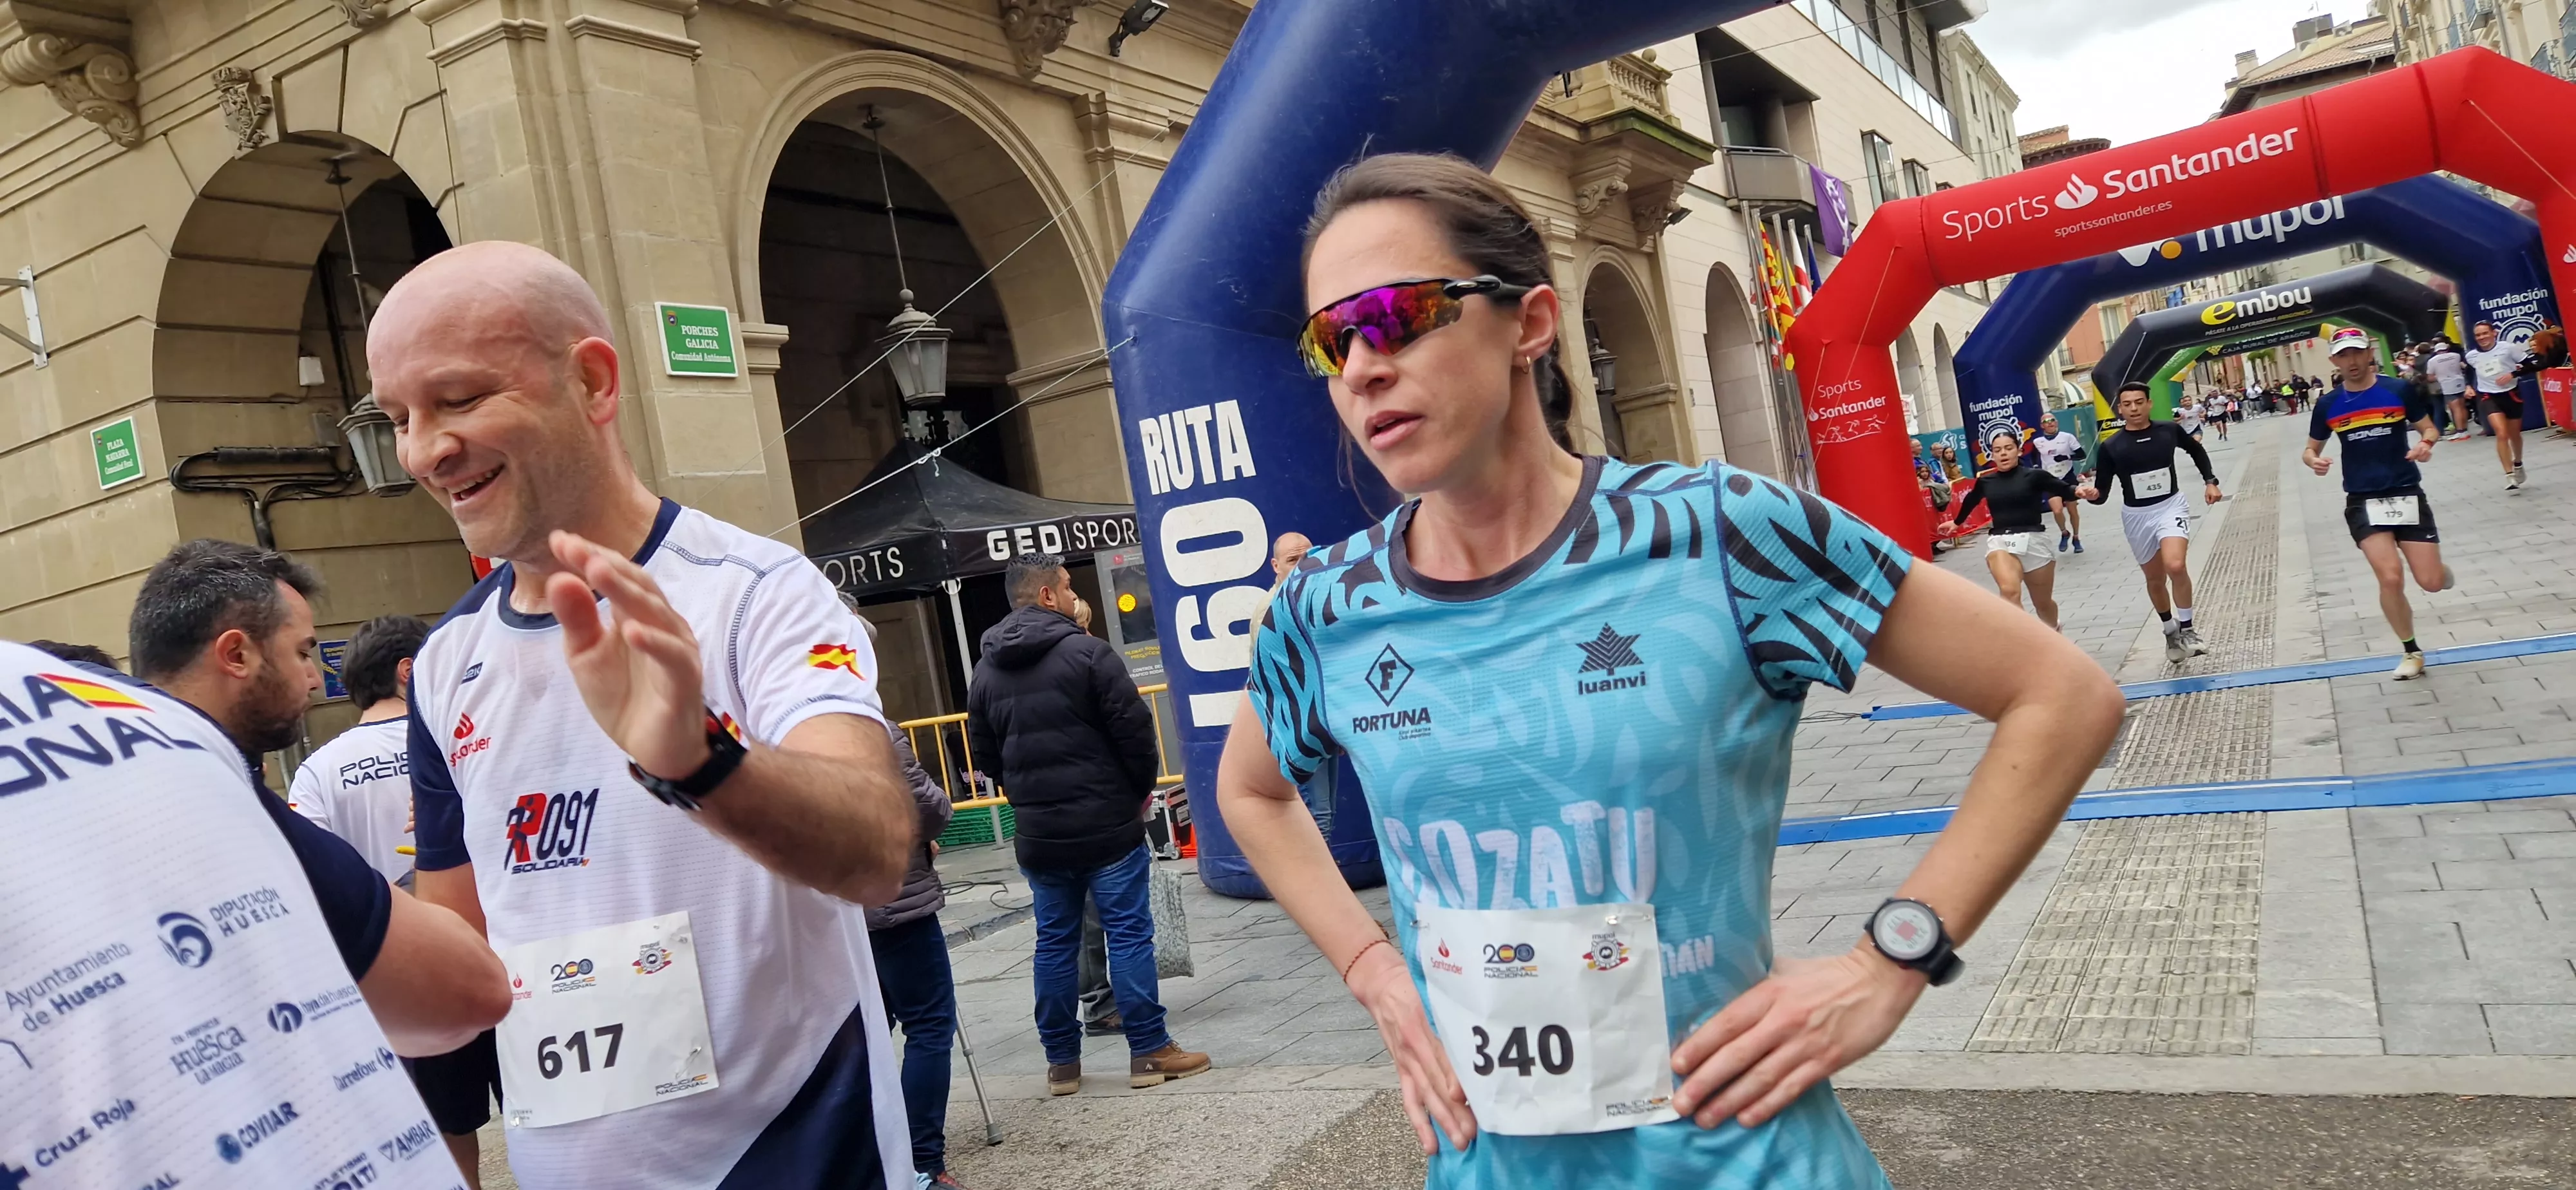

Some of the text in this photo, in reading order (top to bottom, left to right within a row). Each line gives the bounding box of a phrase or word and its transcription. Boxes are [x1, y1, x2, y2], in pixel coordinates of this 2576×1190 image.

[1942, 126, 2299, 241] Sports Santander
[2054, 200, 2173, 238] sportssantander.es
[2201, 286, 2312, 326] embou
[2479, 287, 2548, 310] fundación
[2492, 301, 2538, 320] mupol
[681, 325, 719, 337] PORCHES
[2222, 346, 2241, 354] CAJA
[2242, 341, 2266, 350] RURAL
[2278, 330, 2311, 341] ARAGÓN
[671, 350, 703, 362] Comunidad
[685, 338, 719, 350] GALICIA
[1817, 380, 1862, 399] Sports
[1819, 396, 1886, 420] Santander
[1969, 393, 2023, 413] fundación
[1978, 406, 2014, 421] mupol
[1139, 399, 1256, 495] RUTA
[2146, 483, 2162, 491] 435
[987, 524, 1063, 561] GED
[1578, 672, 1646, 695] luanvi
[1352, 707, 1432, 734] FORTUNA
[209, 886, 279, 922] DIPUTACIÓN
[218, 902, 290, 938] HUESCA
[1592, 932, 1616, 941] mupol
[1483, 943, 1535, 964] 200
[5, 941, 131, 1011] Ayuntamiento
[1430, 957, 1463, 976] Santander
[552, 983, 597, 994] NACIONAL
[22, 972, 126, 1032] de Huesca
[170, 1026, 247, 1076] Huesca
[537, 1023, 623, 1080] 617
[1472, 1024, 1574, 1077] 340
[333, 1060, 379, 1092] Carrefour
[656, 1081, 709, 1097] NACIONAL
[34, 1099, 135, 1167] Cruz Roja
[237, 1101, 299, 1149] COVIAR
[395, 1120, 436, 1158] AMBAR
